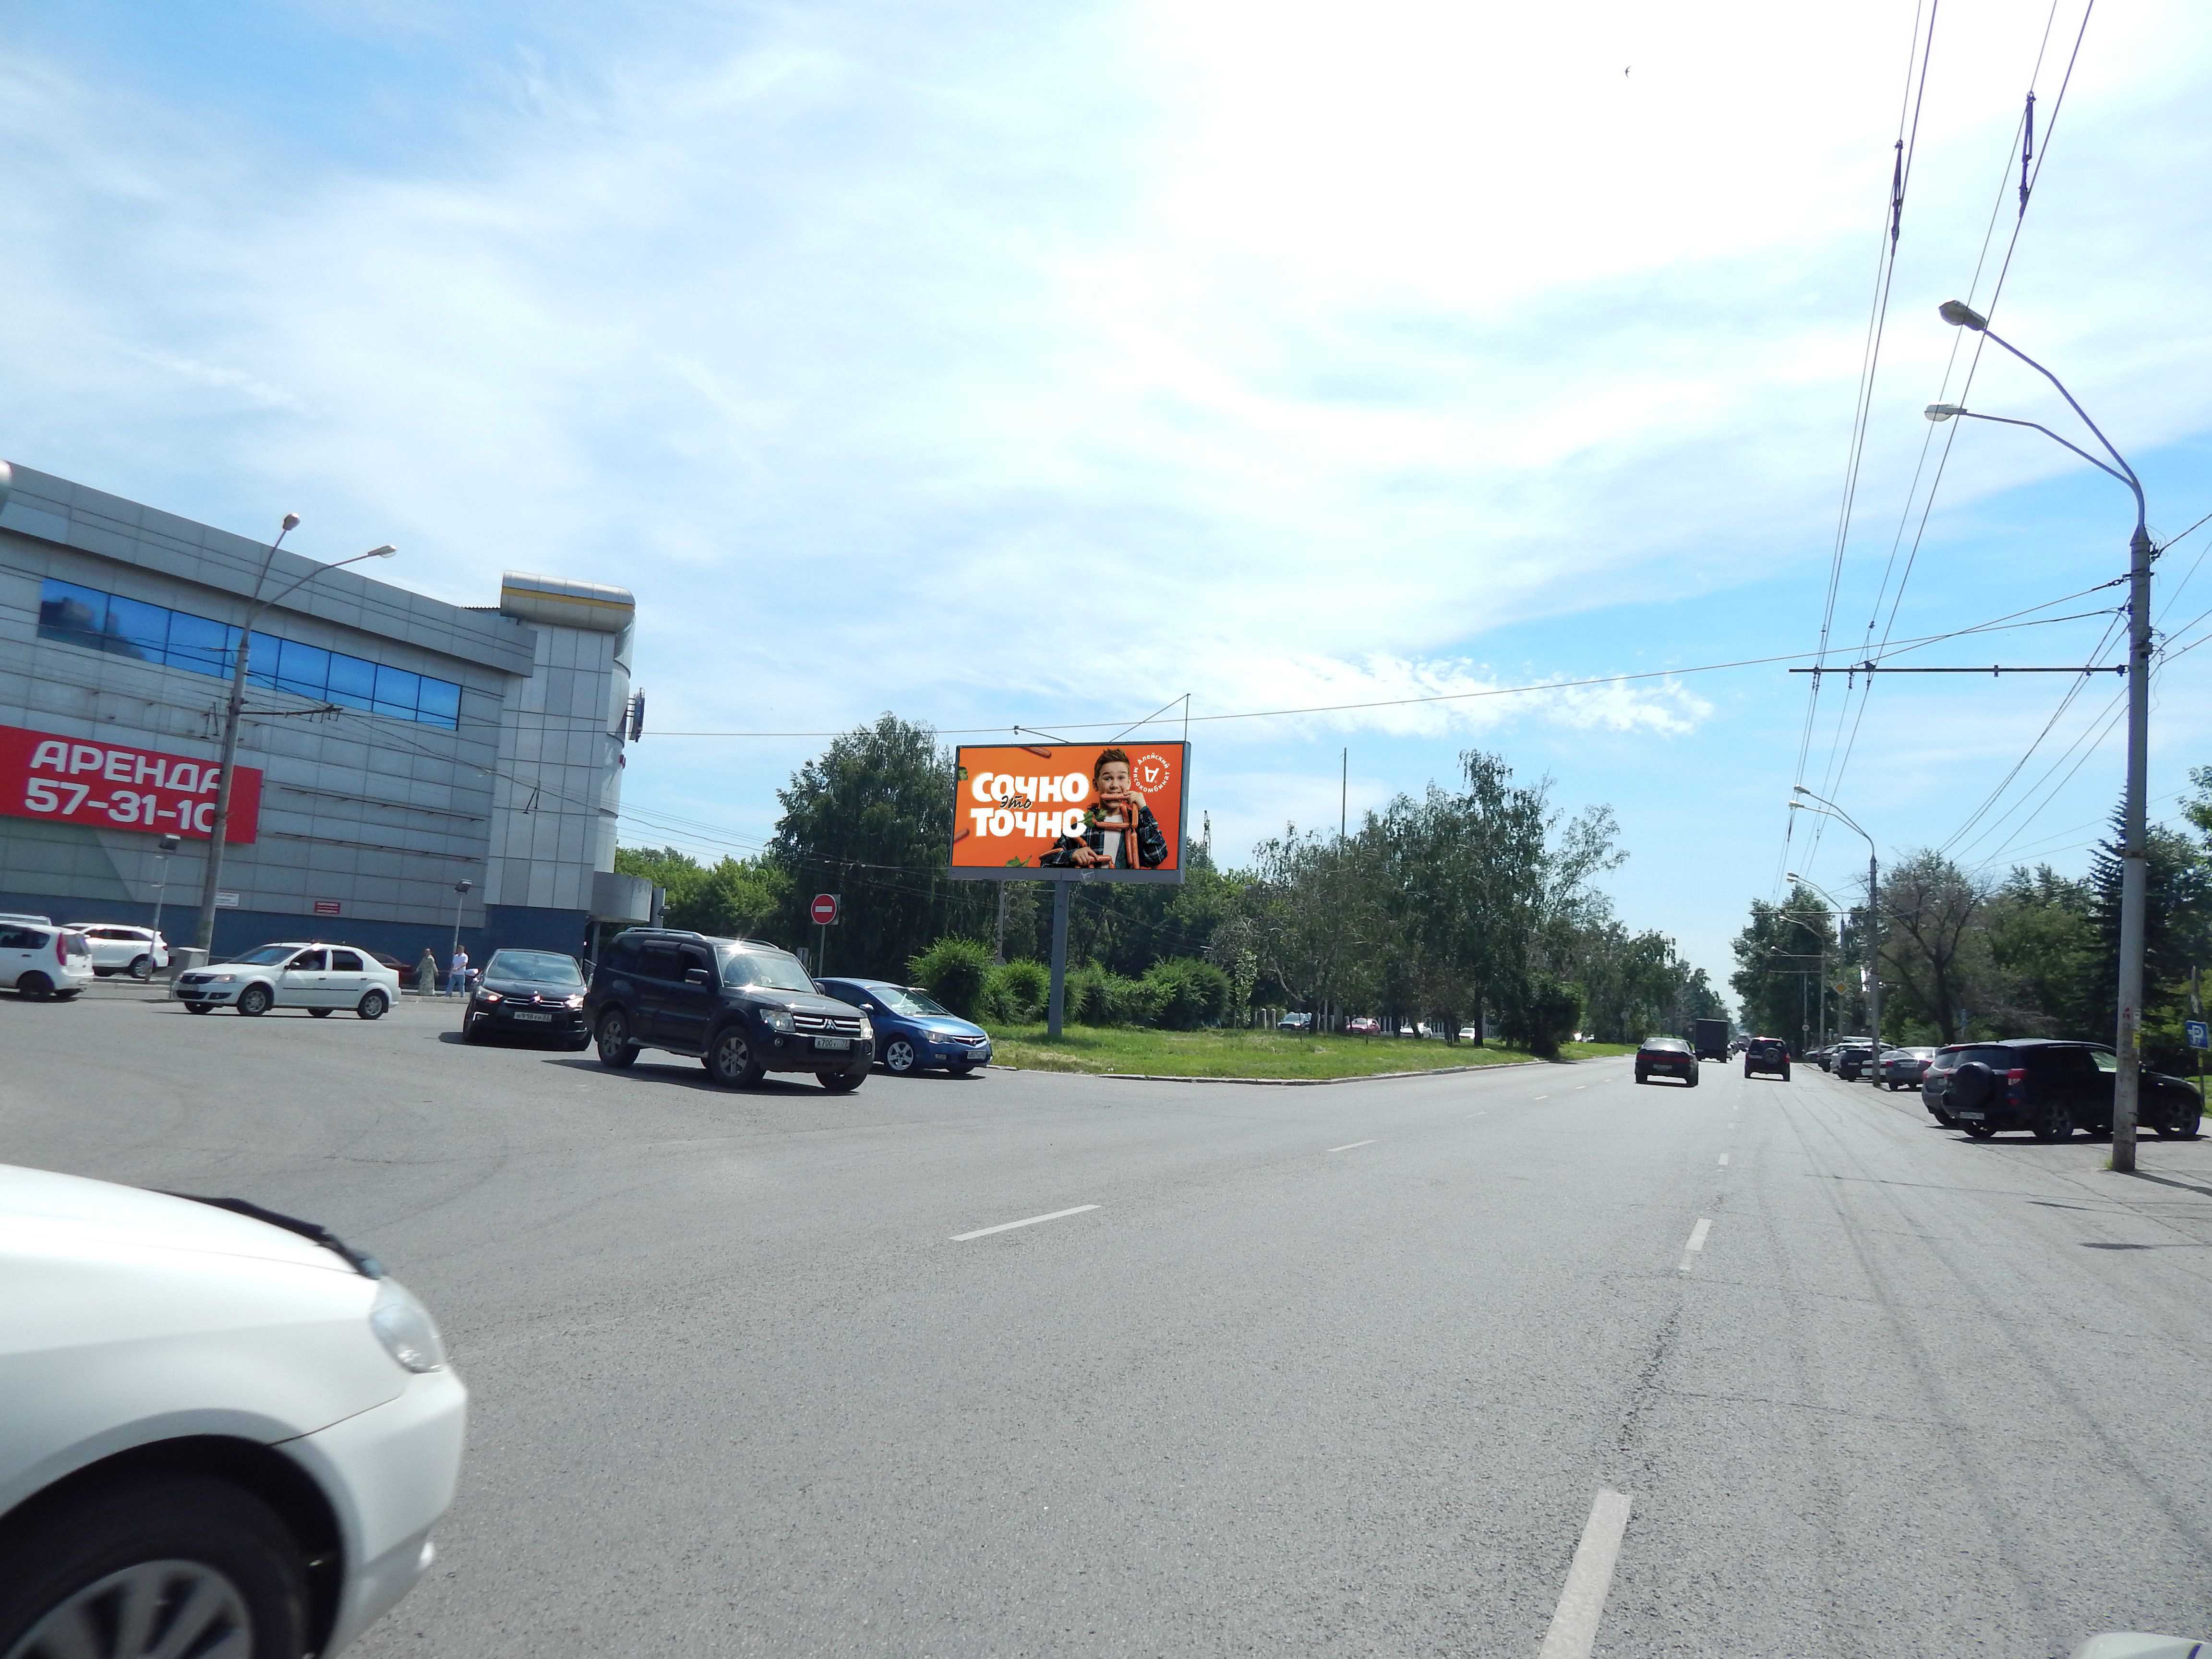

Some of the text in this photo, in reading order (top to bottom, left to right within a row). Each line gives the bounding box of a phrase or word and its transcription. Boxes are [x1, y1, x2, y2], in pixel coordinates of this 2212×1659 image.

[30, 740, 220, 793] АРЕНДА
[1137, 752, 1170, 769] Алейский
[971, 772, 1090, 803] СОЧНО
[1133, 767, 1170, 793] мясокомбинат
[24, 777, 216, 833] 57-31-10
[970, 807, 1087, 838] ТОЧНО
